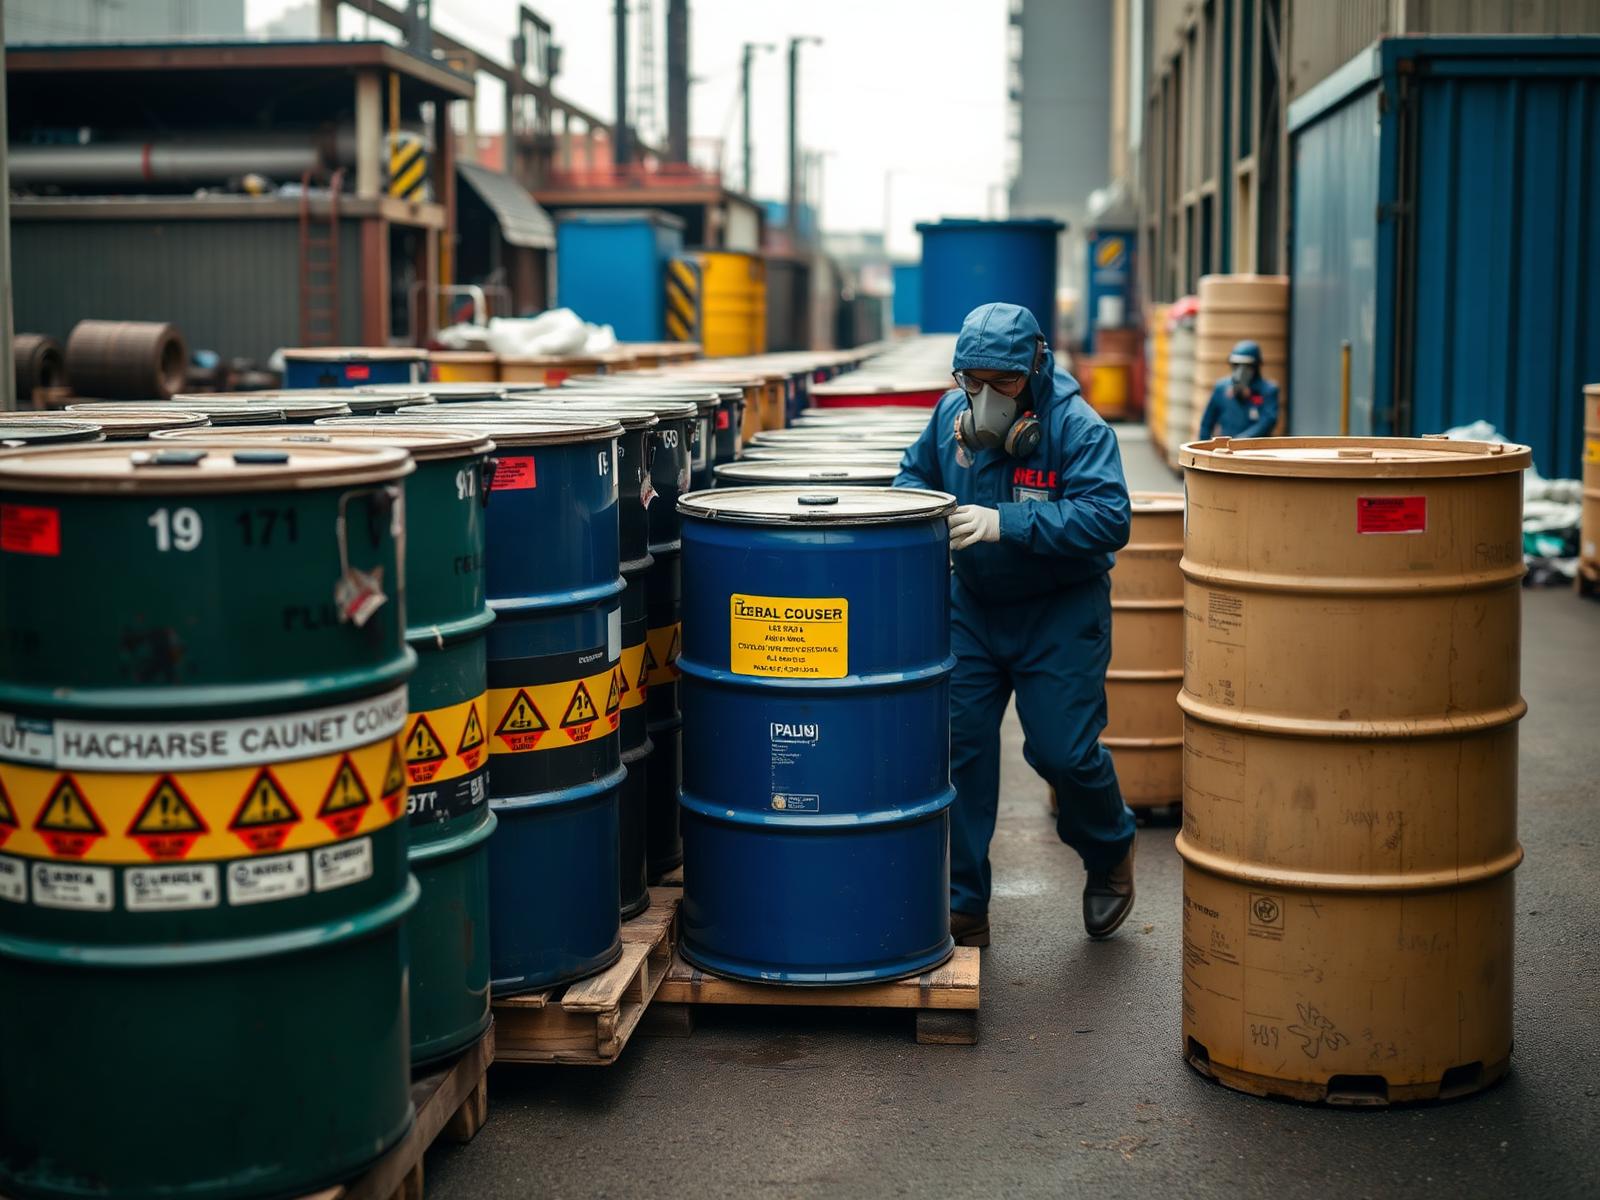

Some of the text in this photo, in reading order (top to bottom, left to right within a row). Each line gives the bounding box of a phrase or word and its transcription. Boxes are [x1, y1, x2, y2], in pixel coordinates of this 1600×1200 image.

[148, 507, 203, 551] 19
[237, 507, 298, 545] 171
[784, 607, 842, 620] COUSER
[62, 728, 228, 758] HACHARSE
[240, 714, 348, 754] CAUNET
